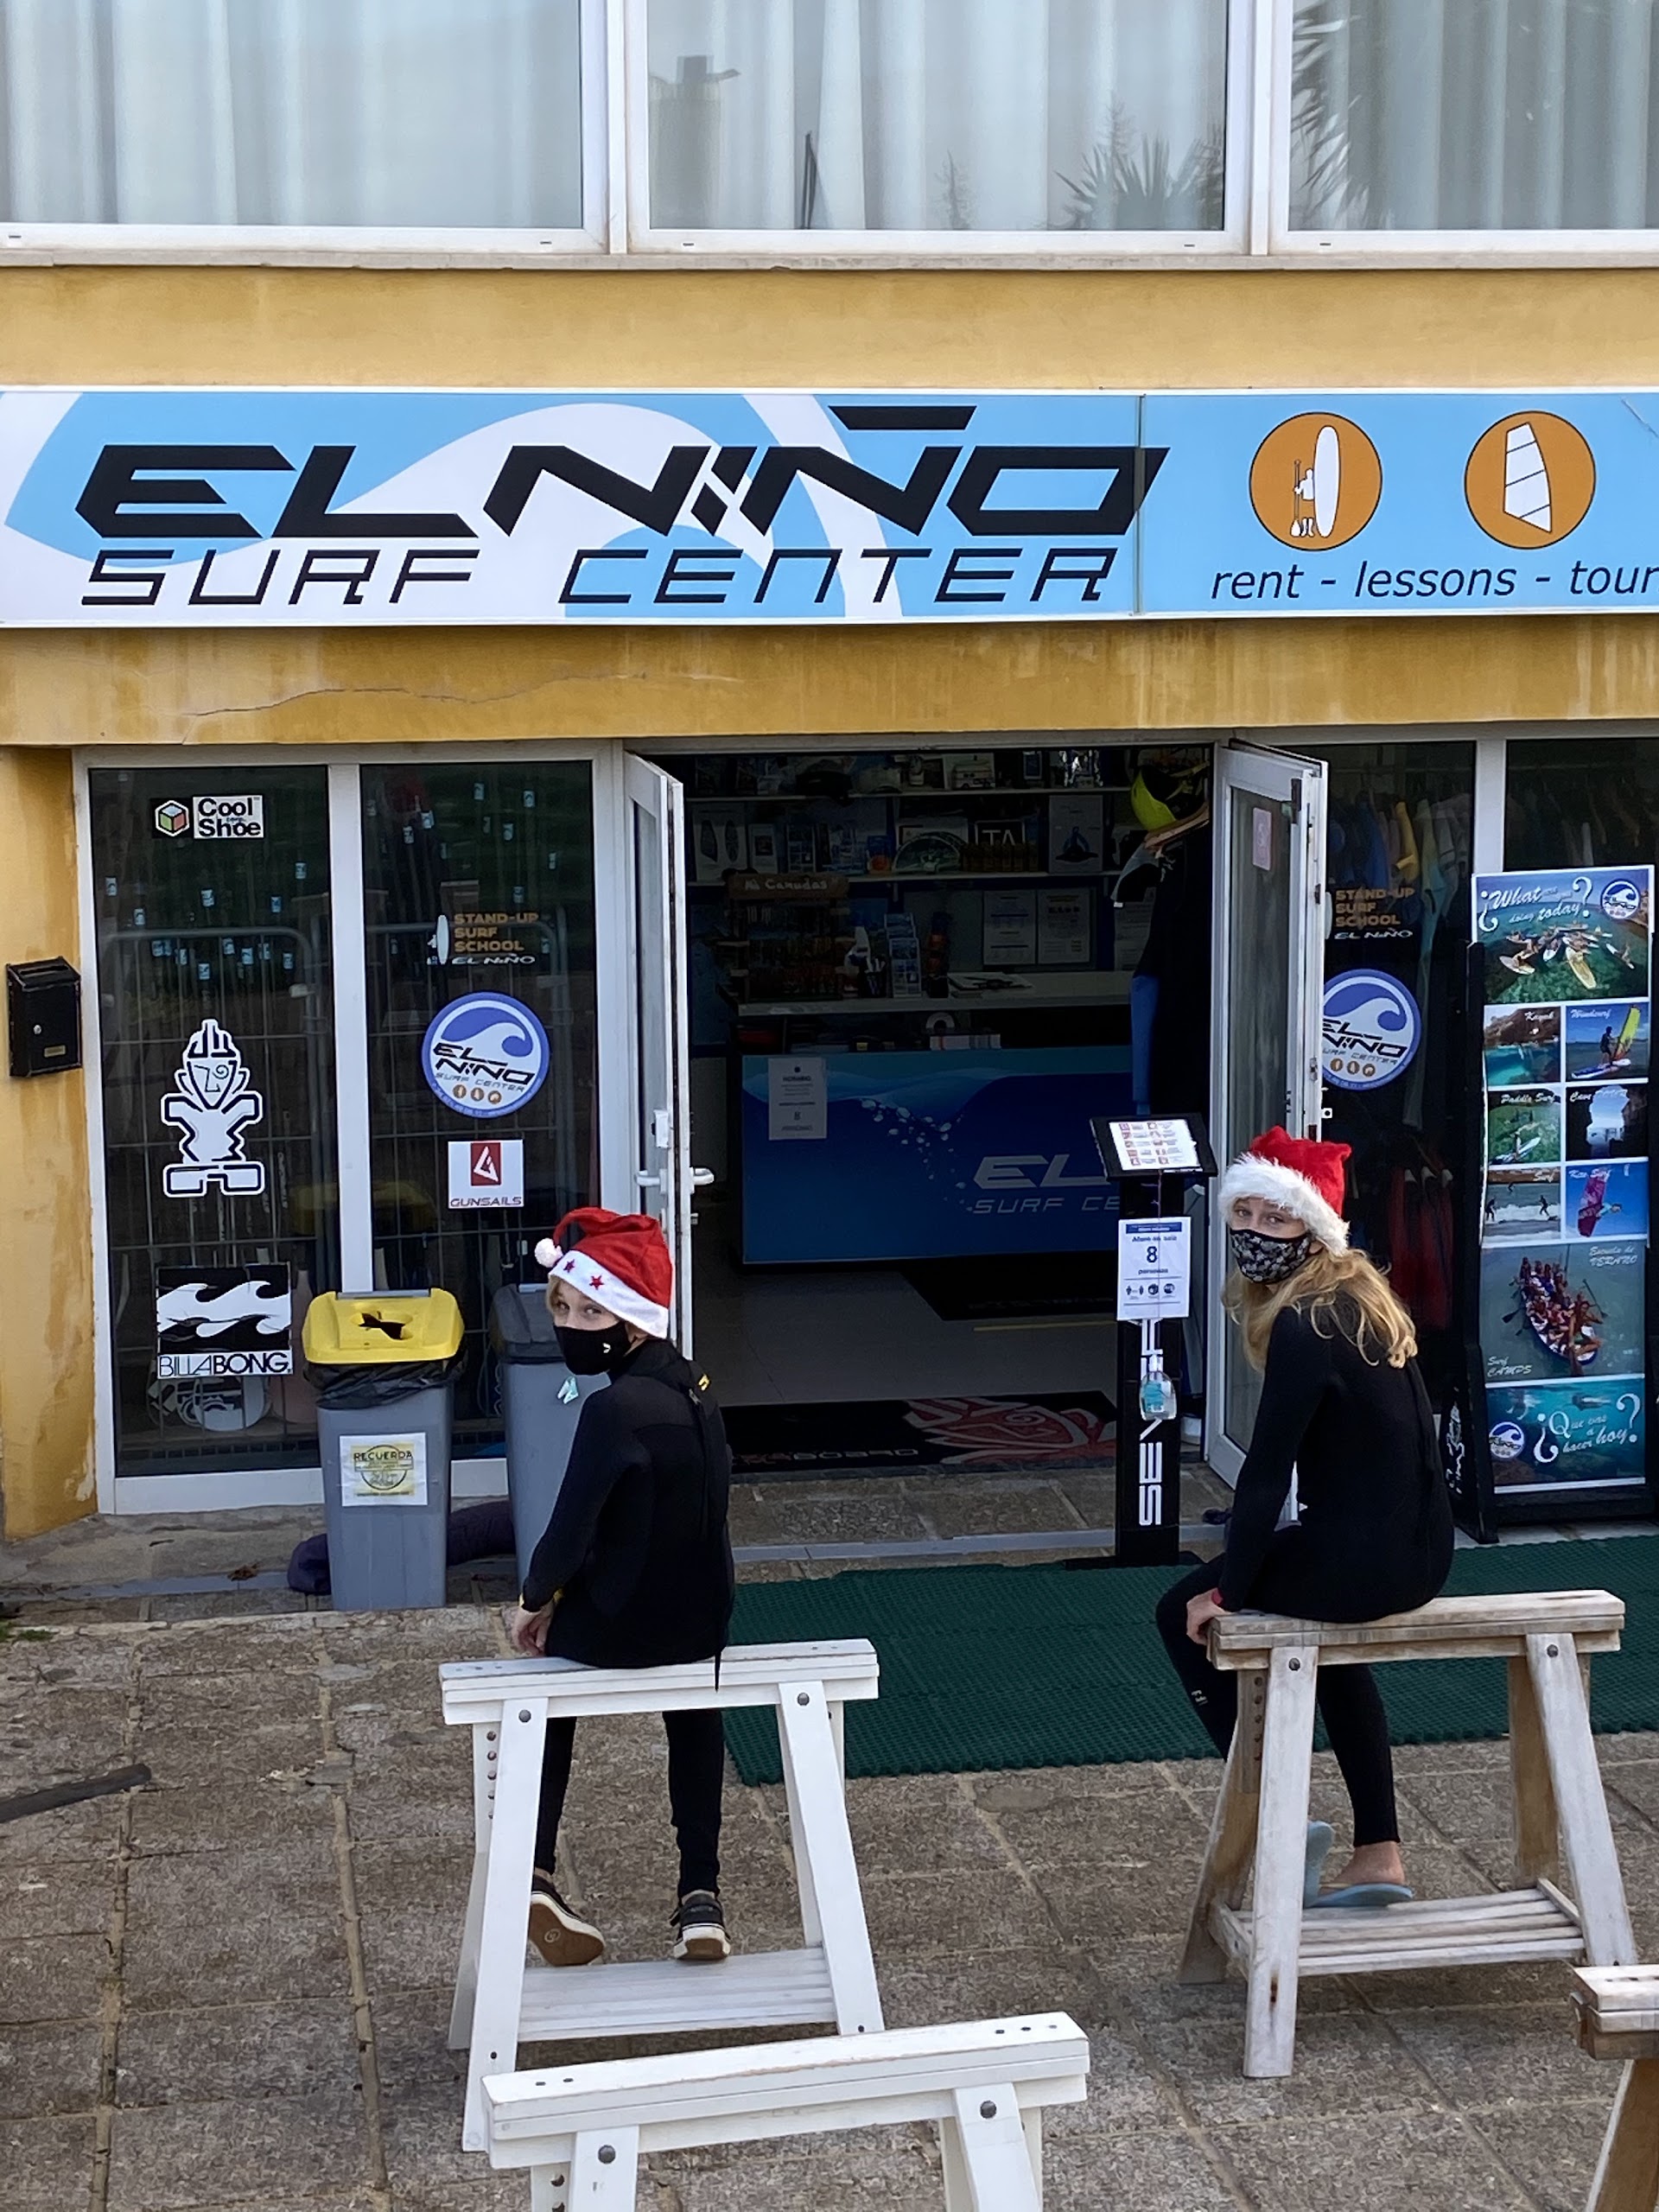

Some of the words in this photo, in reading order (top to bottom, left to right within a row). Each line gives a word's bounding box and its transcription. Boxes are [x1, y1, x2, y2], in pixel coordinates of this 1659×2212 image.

[75, 445, 479, 538] EL
[81, 549, 480, 605] SURF
[558, 548, 1118, 604] CENTER
[1211, 563, 1305, 599] rent
[1355, 561, 1516, 597] lessons
[1570, 561, 1659, 594] tour
[198, 798, 253, 817] Cool
[199, 817, 261, 837] Shoe
[1335, 887, 1415, 901] STAND-UP
[1335, 902, 1376, 914] SURF
[454, 912, 539, 925] STAND-UP
[1335, 914, 1402, 927] SCHOOL
[454, 926, 499, 938] SURF
[454, 940, 525, 952] SCHOOL
[452, 957, 478, 965] EL
[433, 1042, 486, 1064] EL
[435, 1071, 469, 1083] SURF
[474, 1078, 526, 1093] CENTER
[974, 1154, 1111, 1190] EL
[1533, 1171, 1555, 1184] Surf
[450, 1197, 522, 1207] GUNSAILS
[973, 1198, 1065, 1215] SURF
[1147, 1245, 1158, 1263] 8
[159, 1352, 289, 1376] BILLABONG
[353, 1451, 412, 1462] RECUERDA
